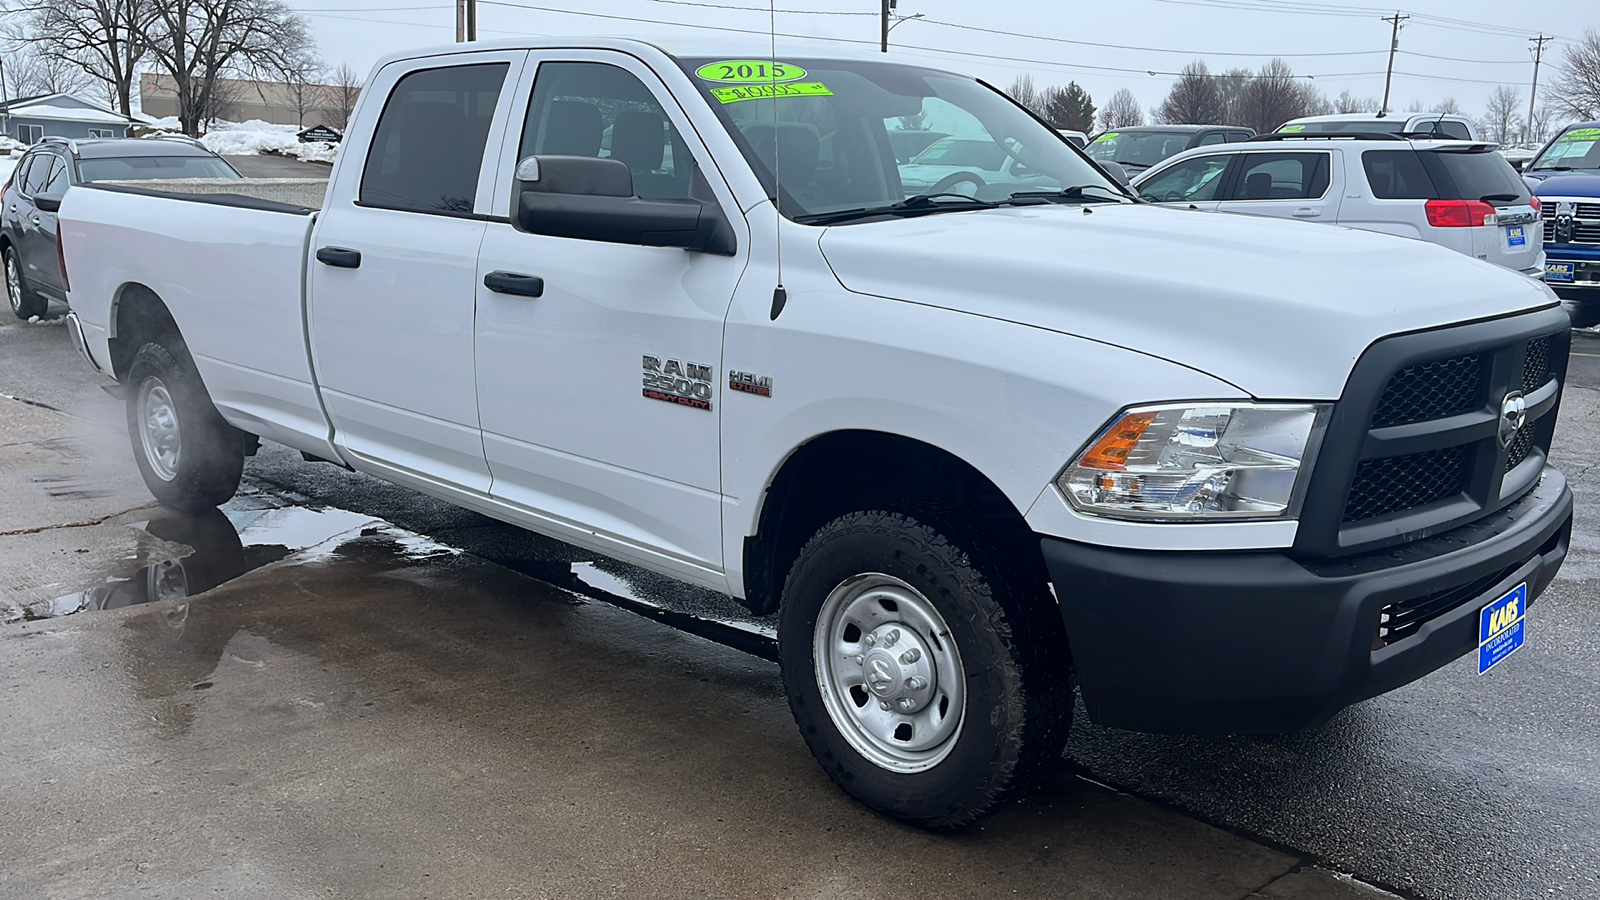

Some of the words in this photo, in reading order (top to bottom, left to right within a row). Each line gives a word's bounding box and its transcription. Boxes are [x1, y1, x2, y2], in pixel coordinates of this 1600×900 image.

[719, 64, 786, 79] 2015
[642, 353, 712, 382] RAM
[729, 369, 773, 388] HEMI
[642, 370, 712, 400] 2500
[744, 384, 769, 396] LITER
[643, 389, 677, 401] HEAVY
[678, 397, 708, 409] DUTY
[1488, 596, 1519, 637] KARS
[1485, 623, 1520, 653] INCORPORATED
